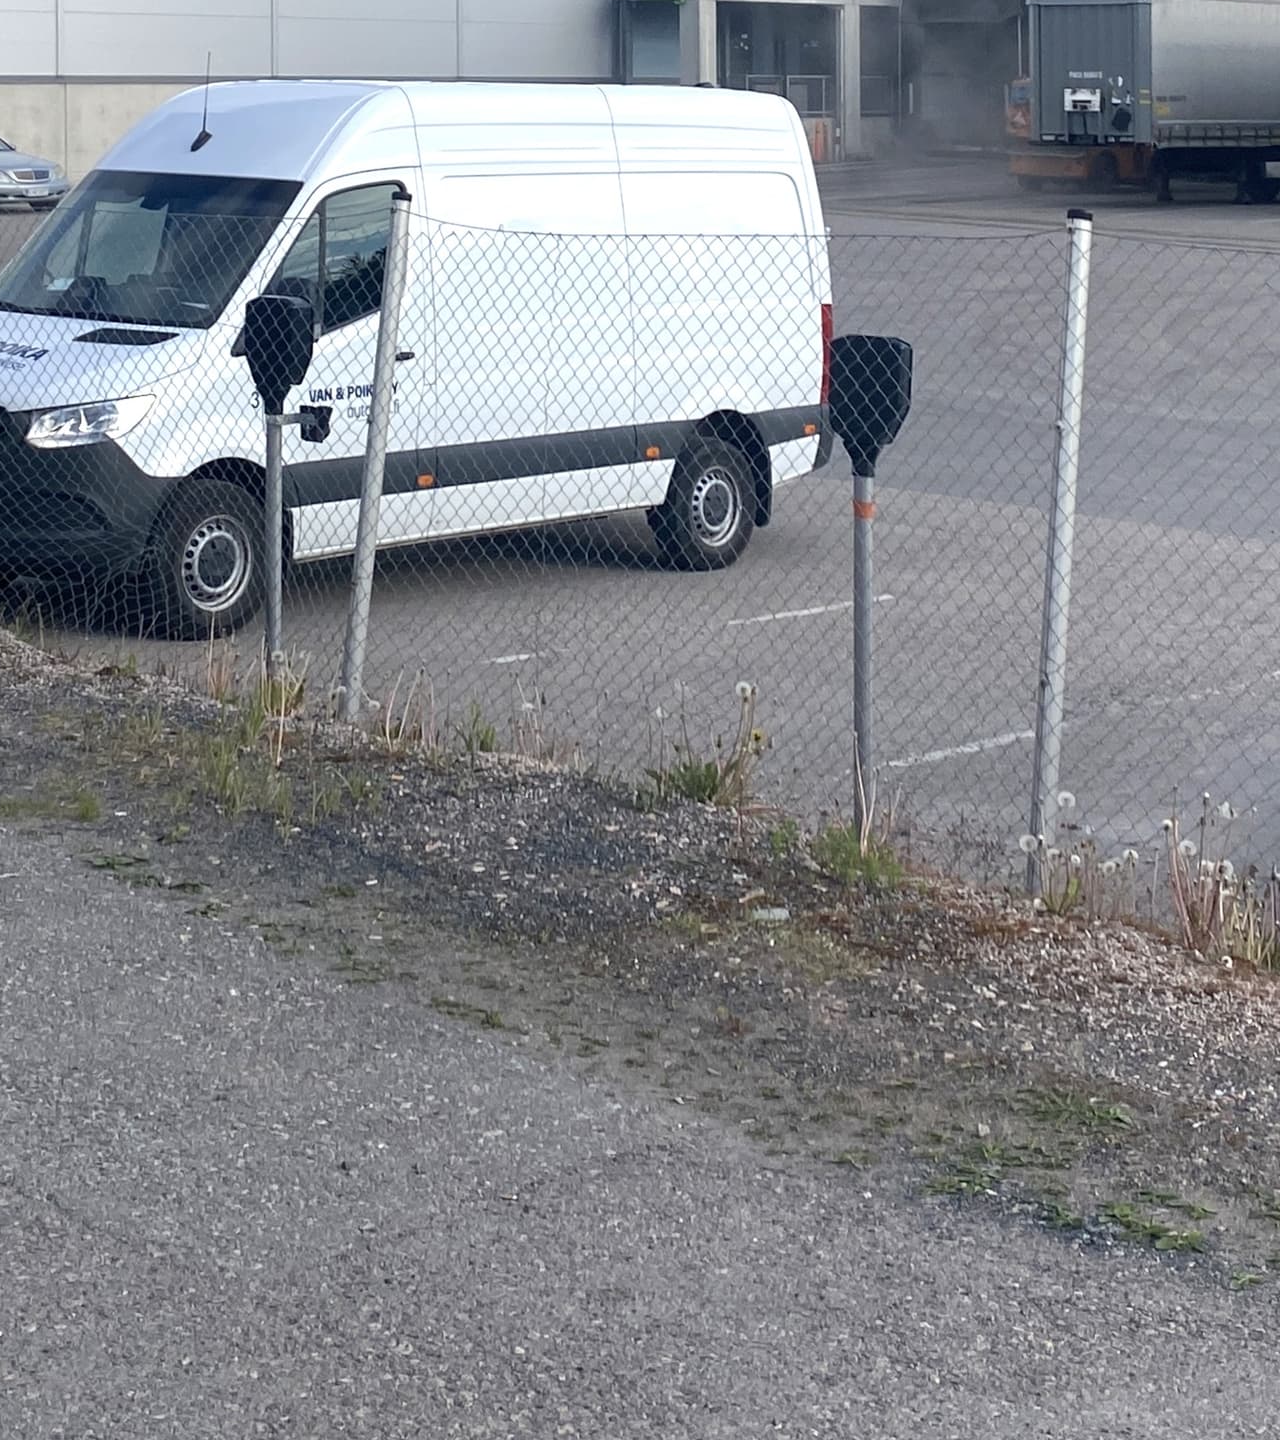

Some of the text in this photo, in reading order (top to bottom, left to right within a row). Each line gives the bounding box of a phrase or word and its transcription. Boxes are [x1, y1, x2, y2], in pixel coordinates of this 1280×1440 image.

[309, 388, 333, 403] VAN
[336, 387, 344, 400] &
[347, 383, 375, 399] POIK
